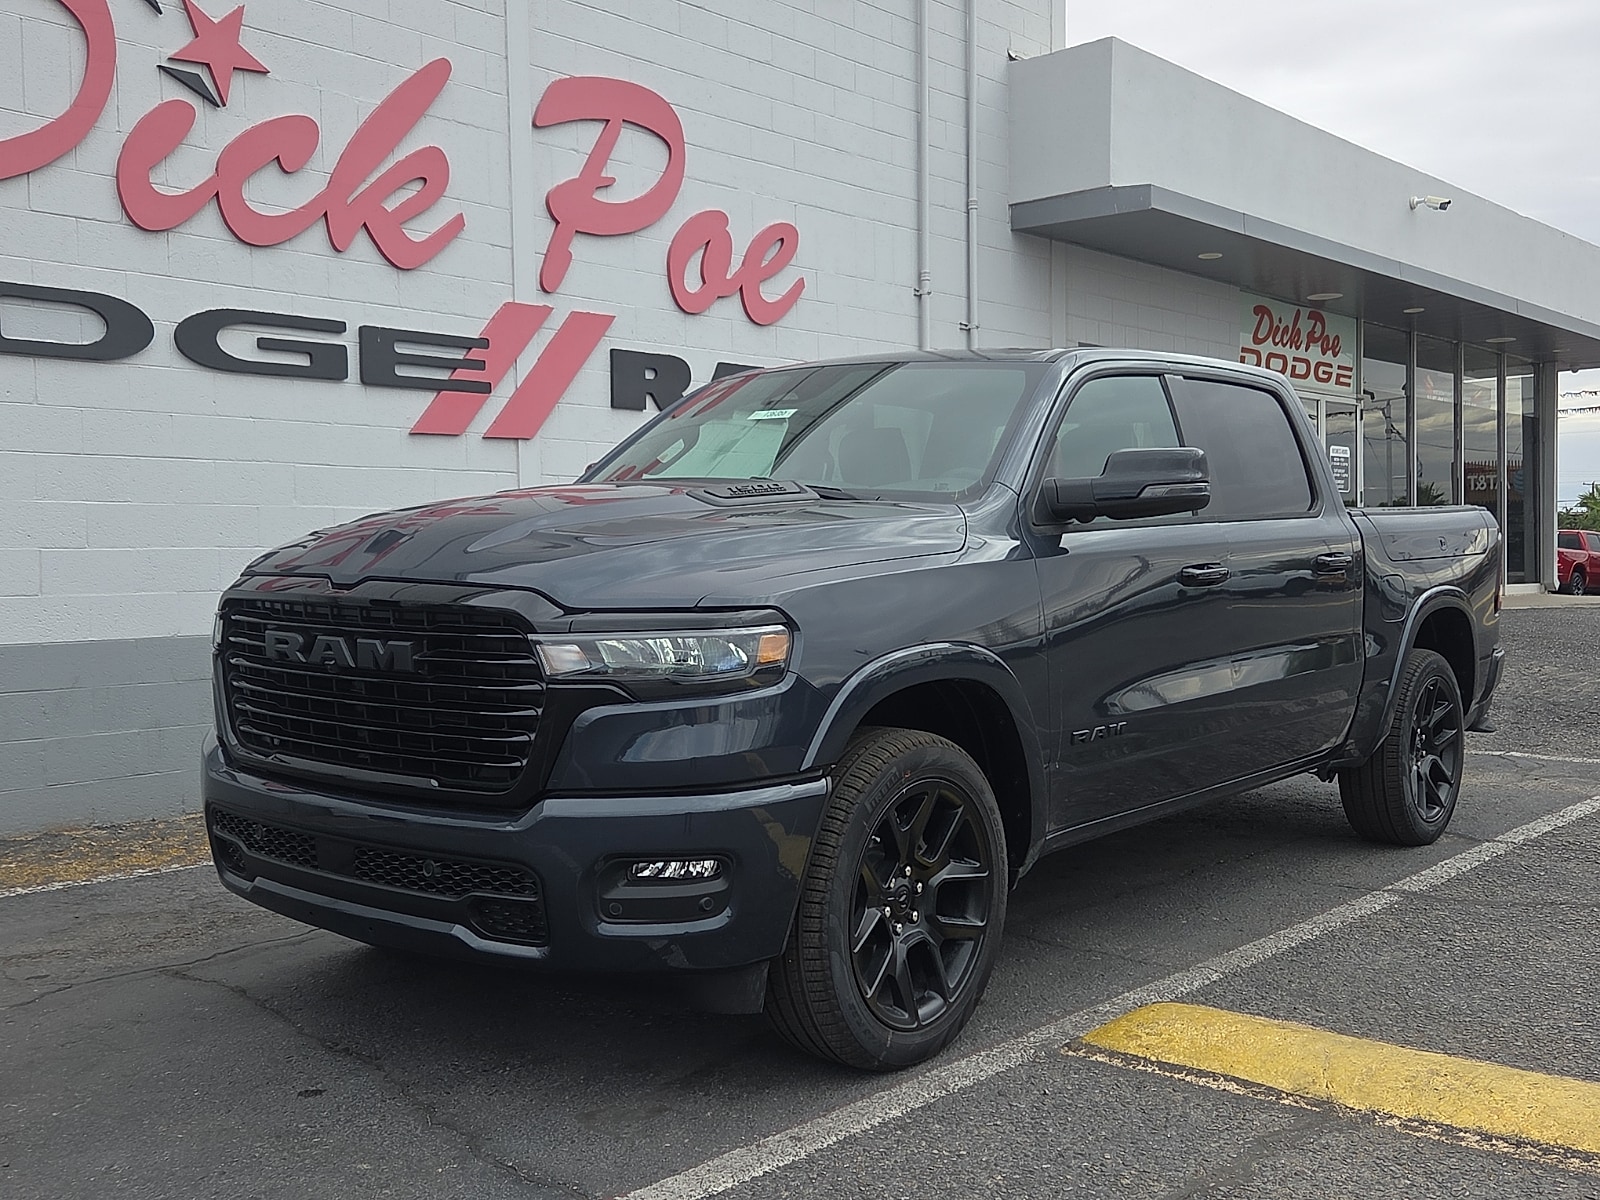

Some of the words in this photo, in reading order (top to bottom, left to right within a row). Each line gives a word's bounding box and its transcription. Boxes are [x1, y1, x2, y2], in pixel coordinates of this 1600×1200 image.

[533, 76, 806, 326] Poe
[1252, 304, 1303, 351] Dick
[1304, 310, 1342, 358] Poe
[609, 348, 766, 411] R
[1239, 346, 1354, 388] DODGE
[264, 629, 418, 672] RAM
